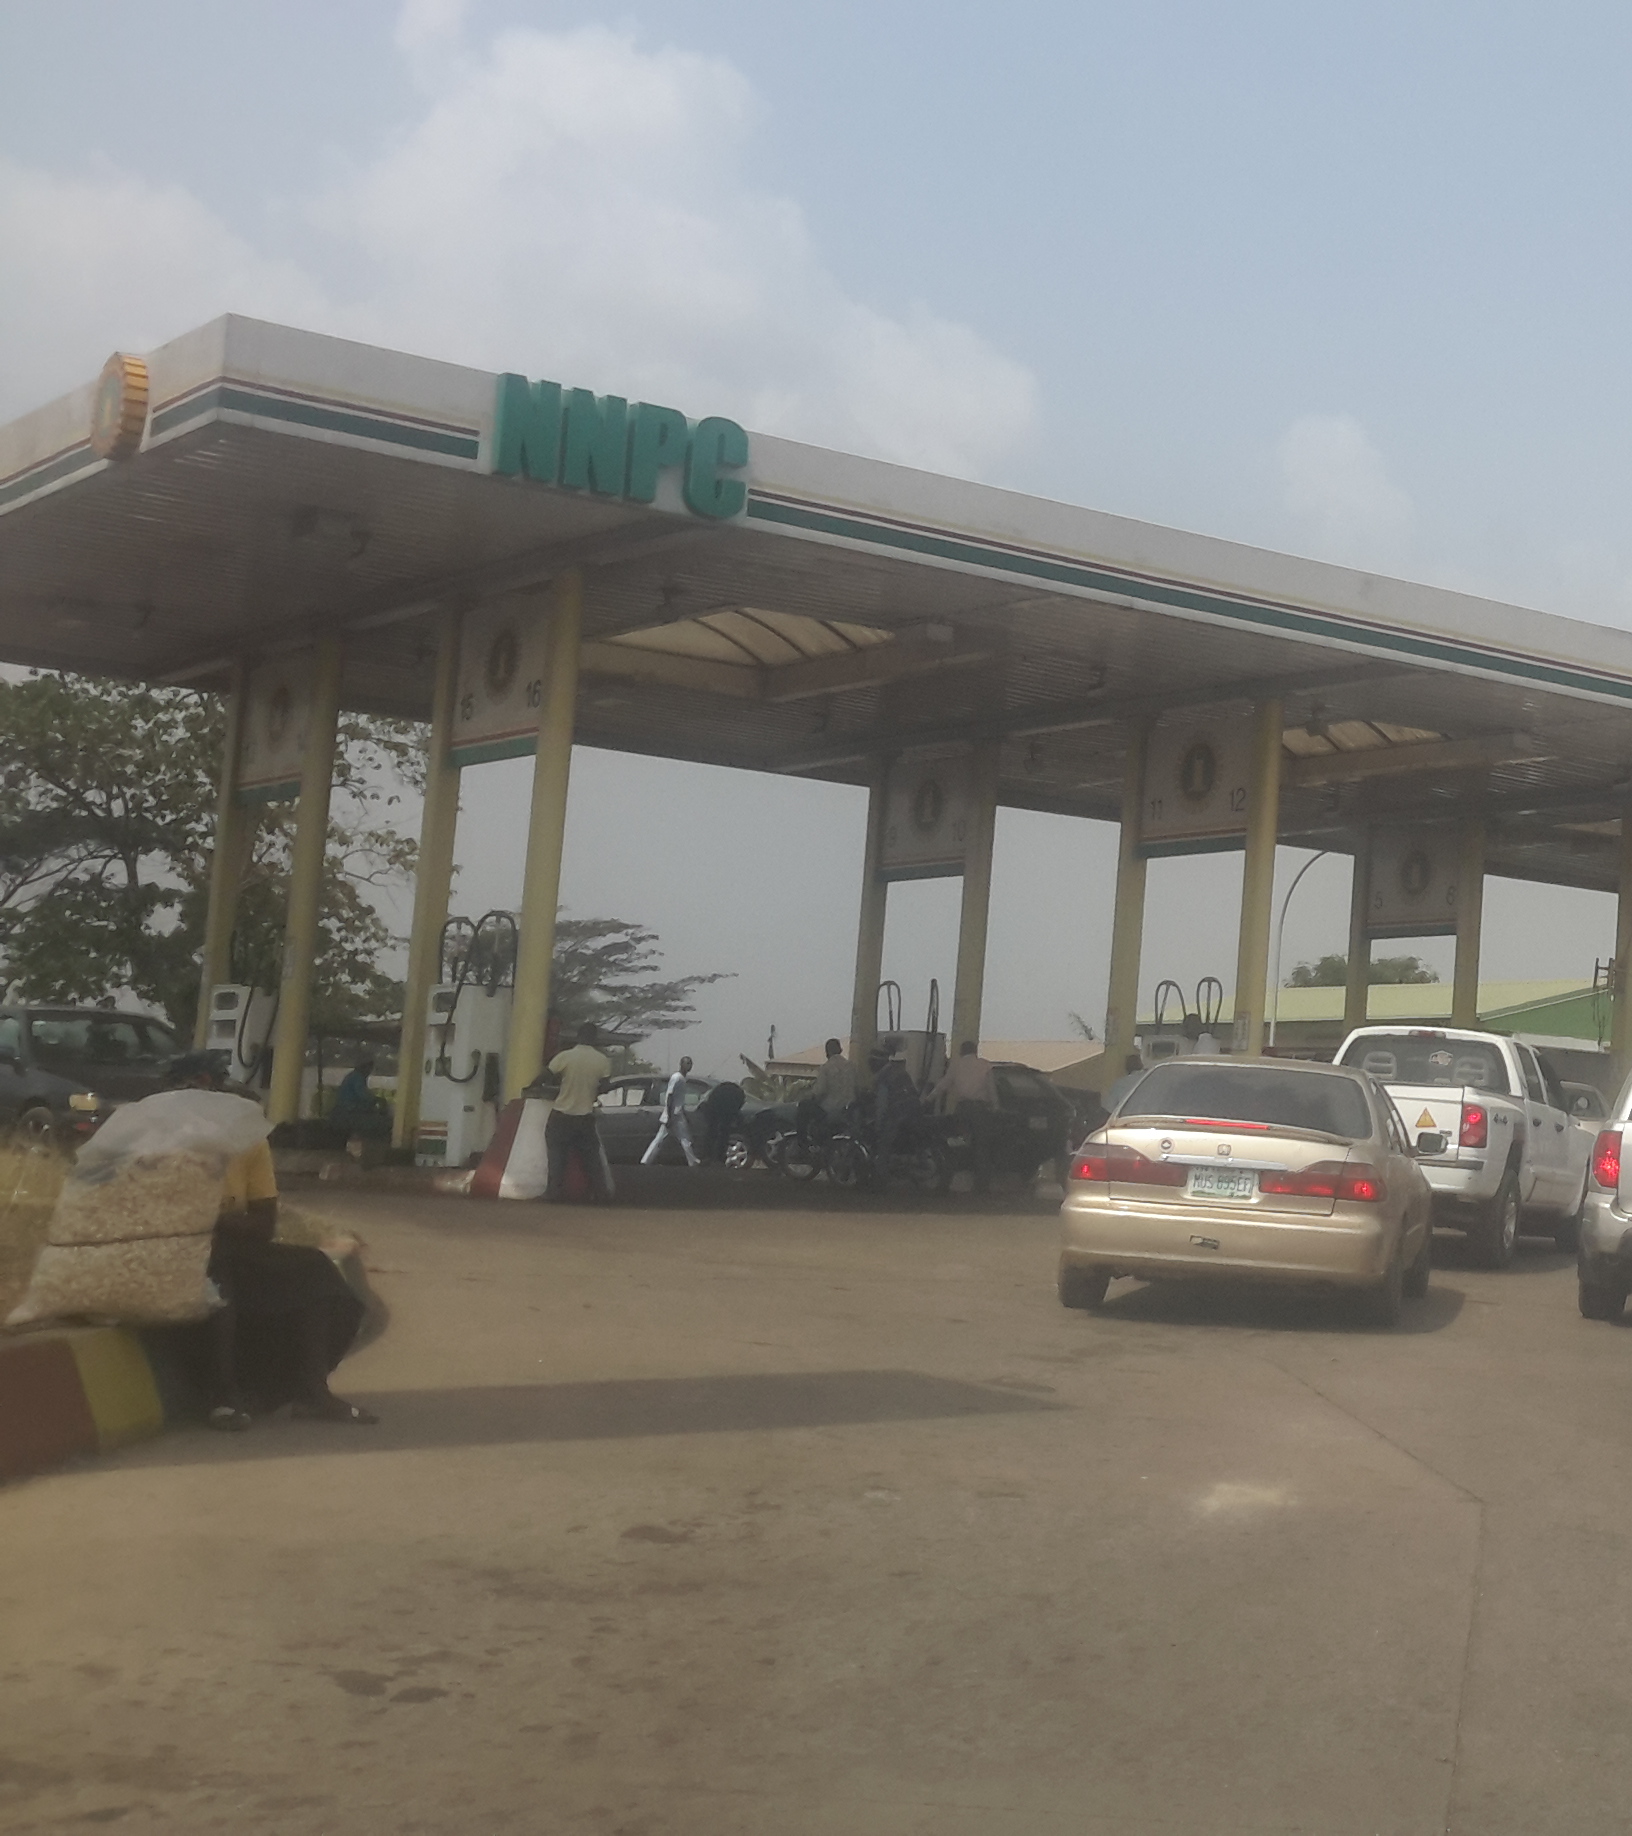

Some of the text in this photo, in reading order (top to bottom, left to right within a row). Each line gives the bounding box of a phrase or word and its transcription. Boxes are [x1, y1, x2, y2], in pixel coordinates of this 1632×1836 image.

[491, 372, 749, 519] NNPC
[526, 679, 542, 708] 16
[1229, 787, 1247, 812] 12
